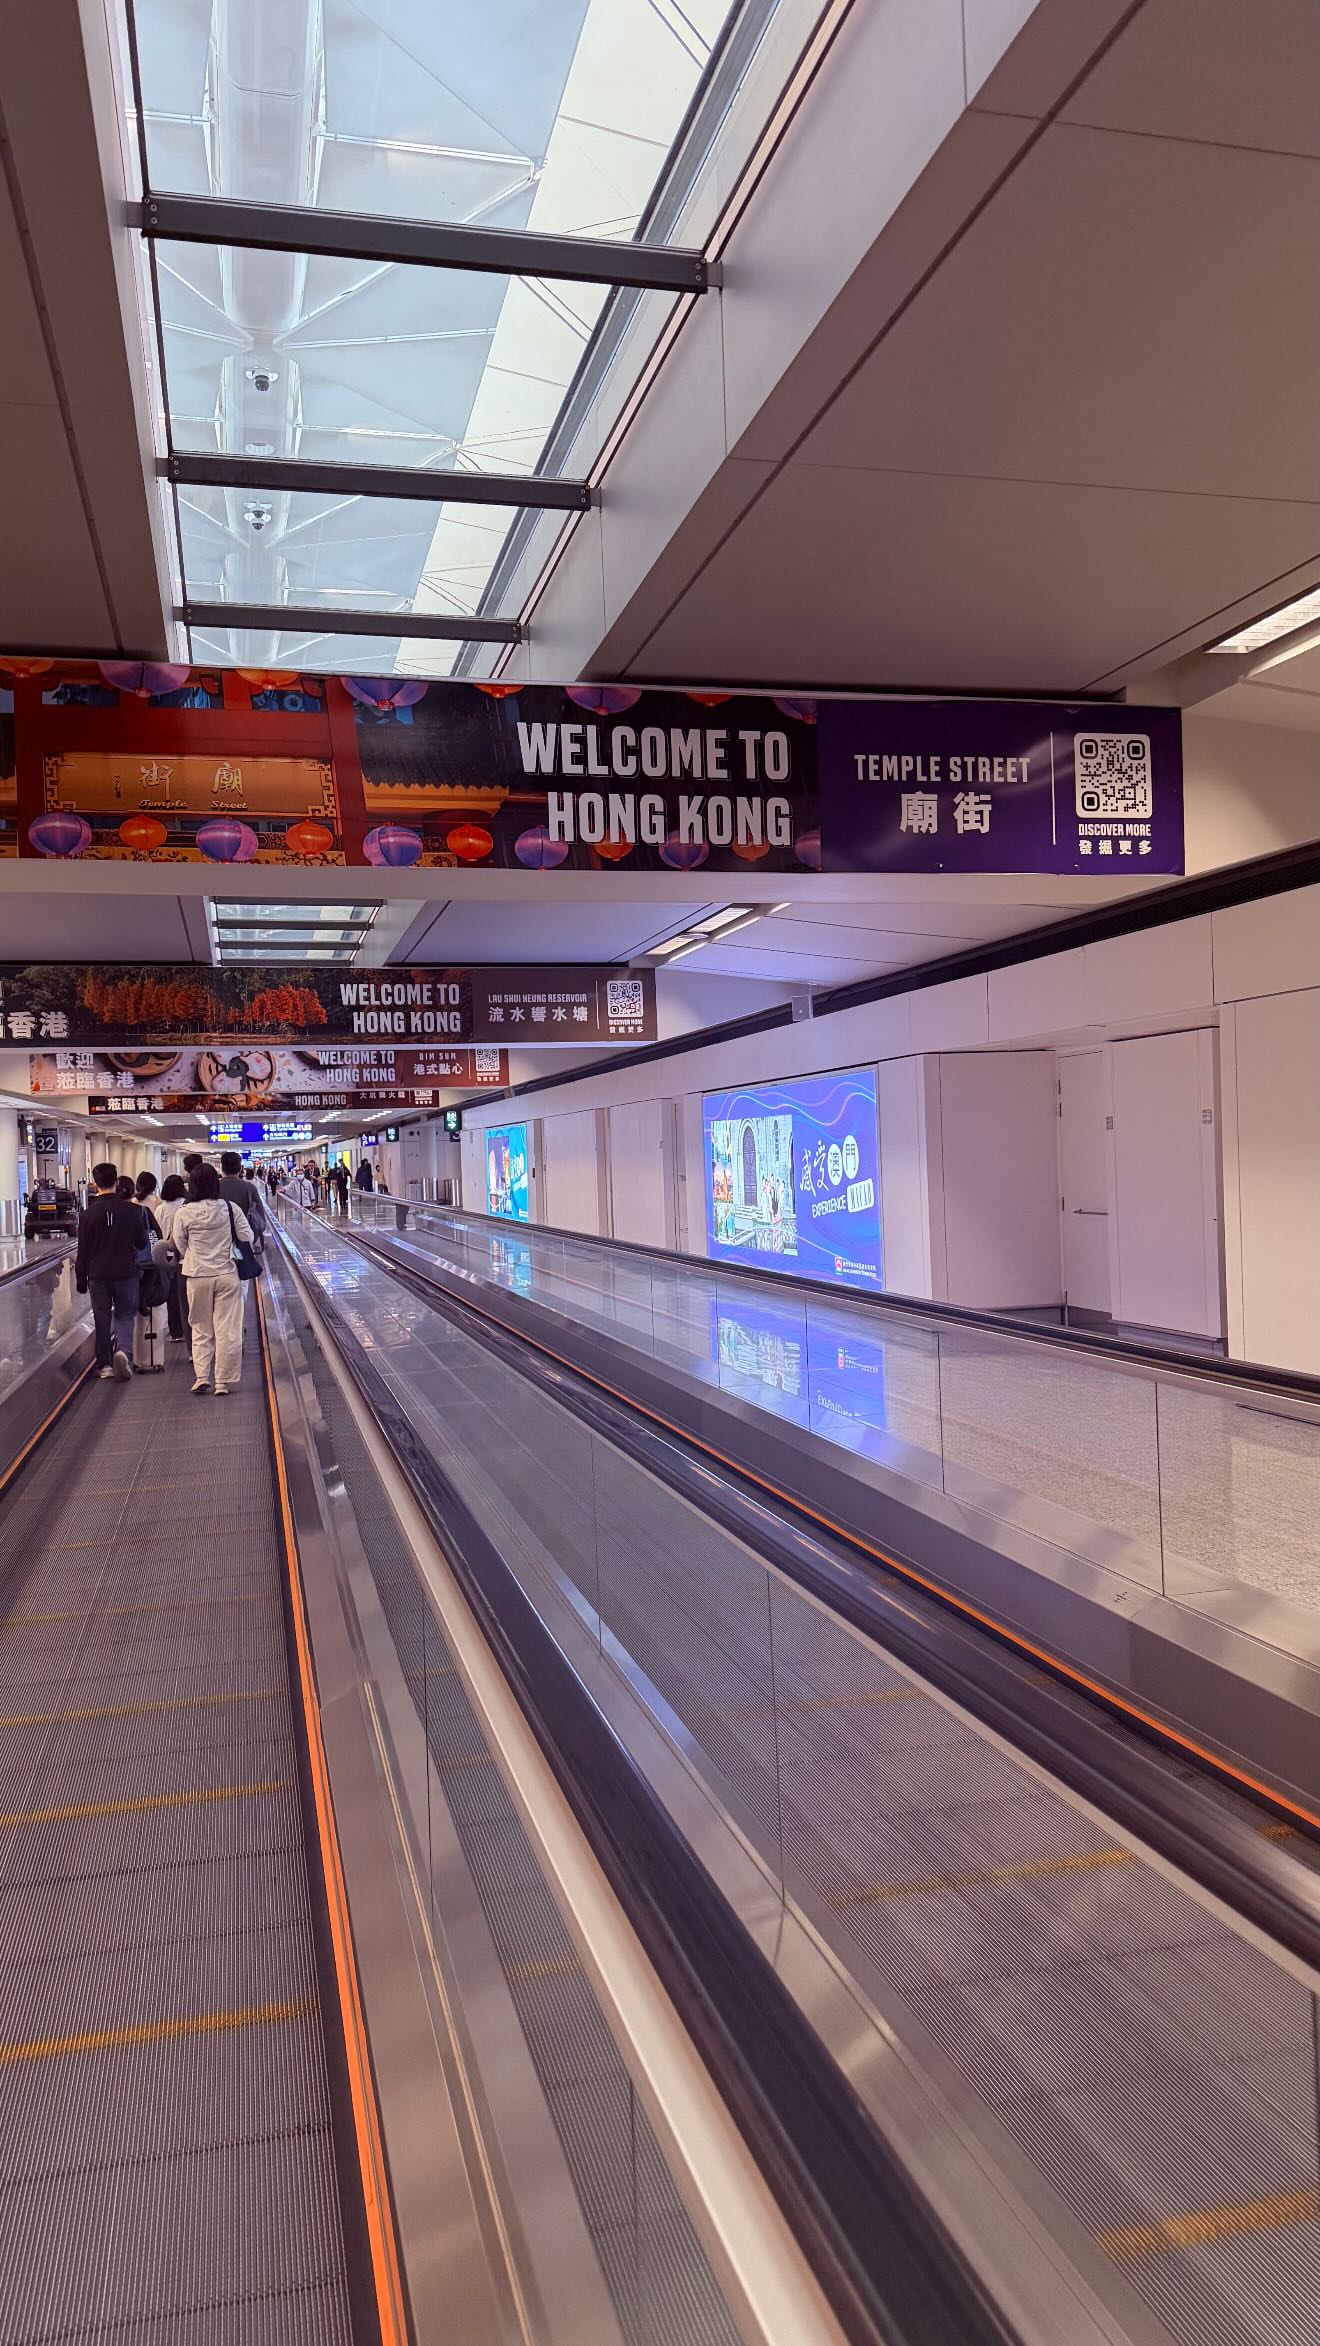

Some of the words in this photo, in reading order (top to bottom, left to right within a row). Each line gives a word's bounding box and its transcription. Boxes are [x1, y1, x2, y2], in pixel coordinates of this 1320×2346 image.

[517, 722, 730, 780] WELCOME
[739, 731, 791, 782] TO
[854, 755, 941, 782] TEMPLE
[950, 757, 1031, 783] STREET
[138, 799, 190, 811] Temple
[209, 800, 249, 810] Street
[899, 791, 993, 834] 廟街
[548, 792, 668, 845] HONG
[679, 796, 794, 847] KONG
[1078, 823, 1124, 837] DISCOVER
[1125, 824, 1152, 837] MORE
[340, 984, 432, 1006] WELCOME
[437, 984, 460, 1006] TO
[353, 1012, 405, 1033] HONG
[410, 1012, 462, 1033] KONG
[319, 1051, 377, 1065] WELCOME
[380, 1051, 395, 1064] TO
[326, 1069, 359, 1082] HONG
[363, 1069, 396, 1082] KONG
[295, 1095, 320, 1107] HONG
[322, 1094, 346, 1106] KONG
[36, 1136, 56, 1152] 32
